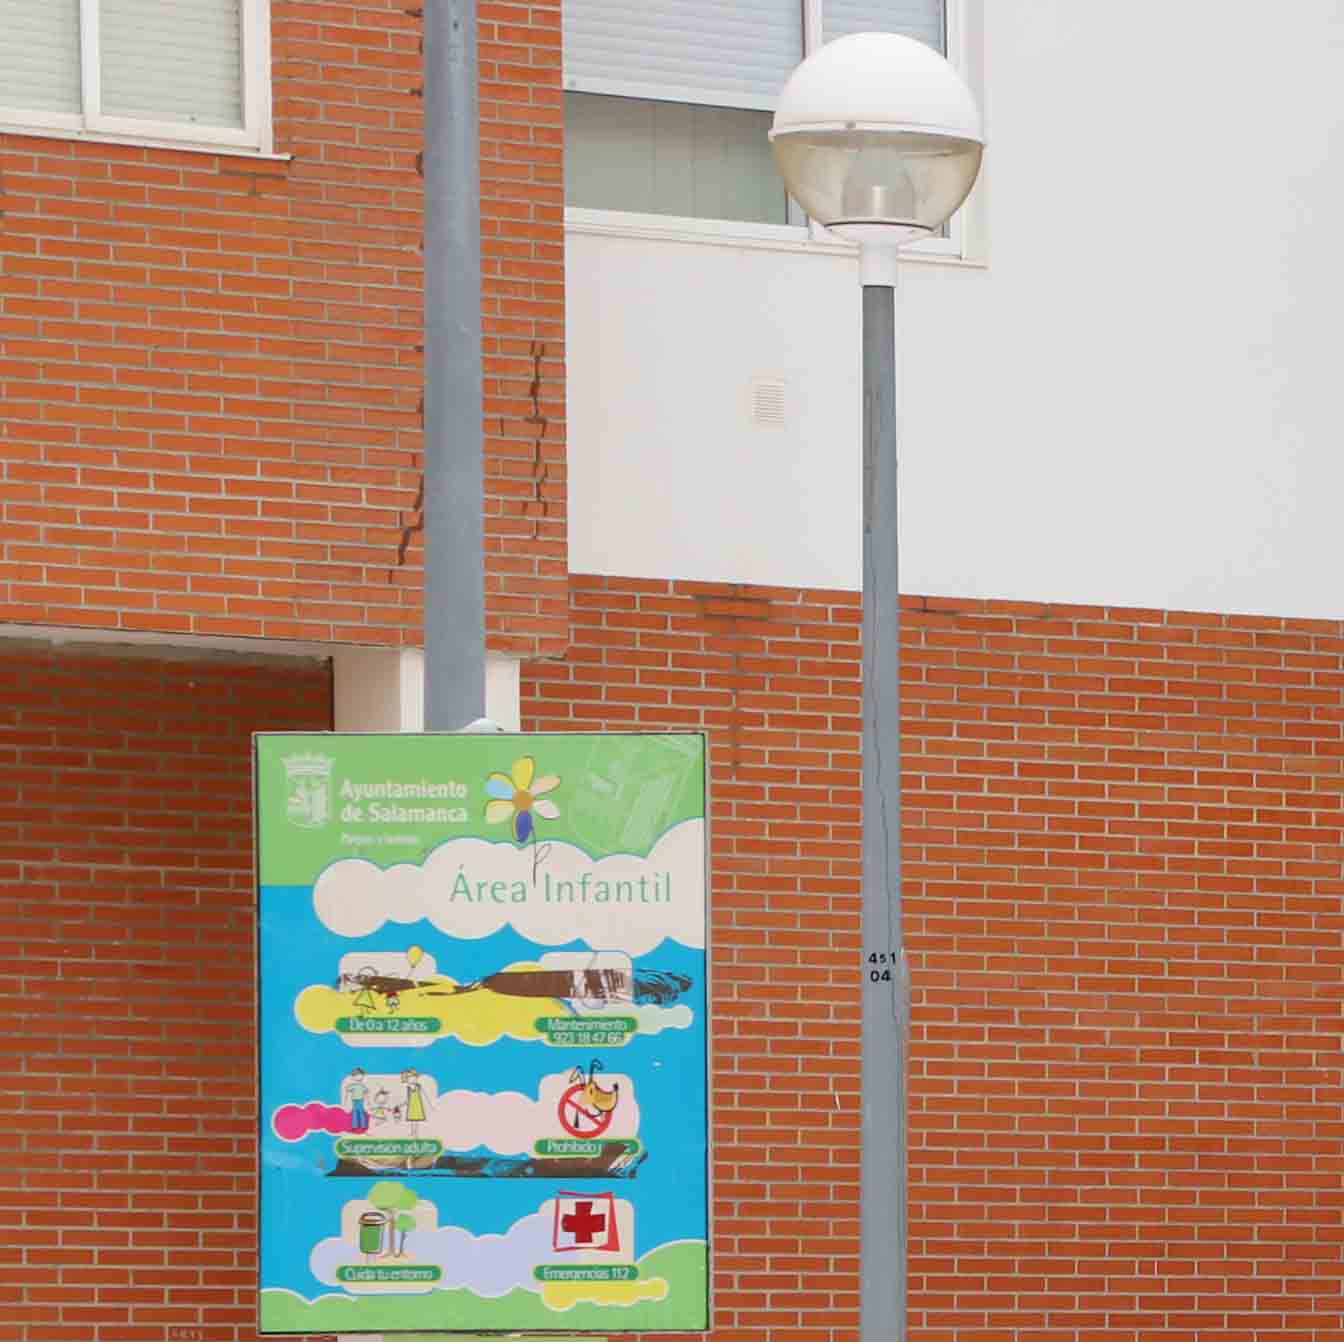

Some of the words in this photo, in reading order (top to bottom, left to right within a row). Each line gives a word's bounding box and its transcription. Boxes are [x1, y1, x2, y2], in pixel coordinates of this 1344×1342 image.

[340, 778, 468, 801] Ayuntamiento
[340, 802, 363, 823] de
[367, 802, 468, 823] Salamanca
[449, 863, 527, 903] Área
[544, 871, 672, 903] Infantil
[867, 951, 896, 966] 451
[869, 969, 892, 983] 04
